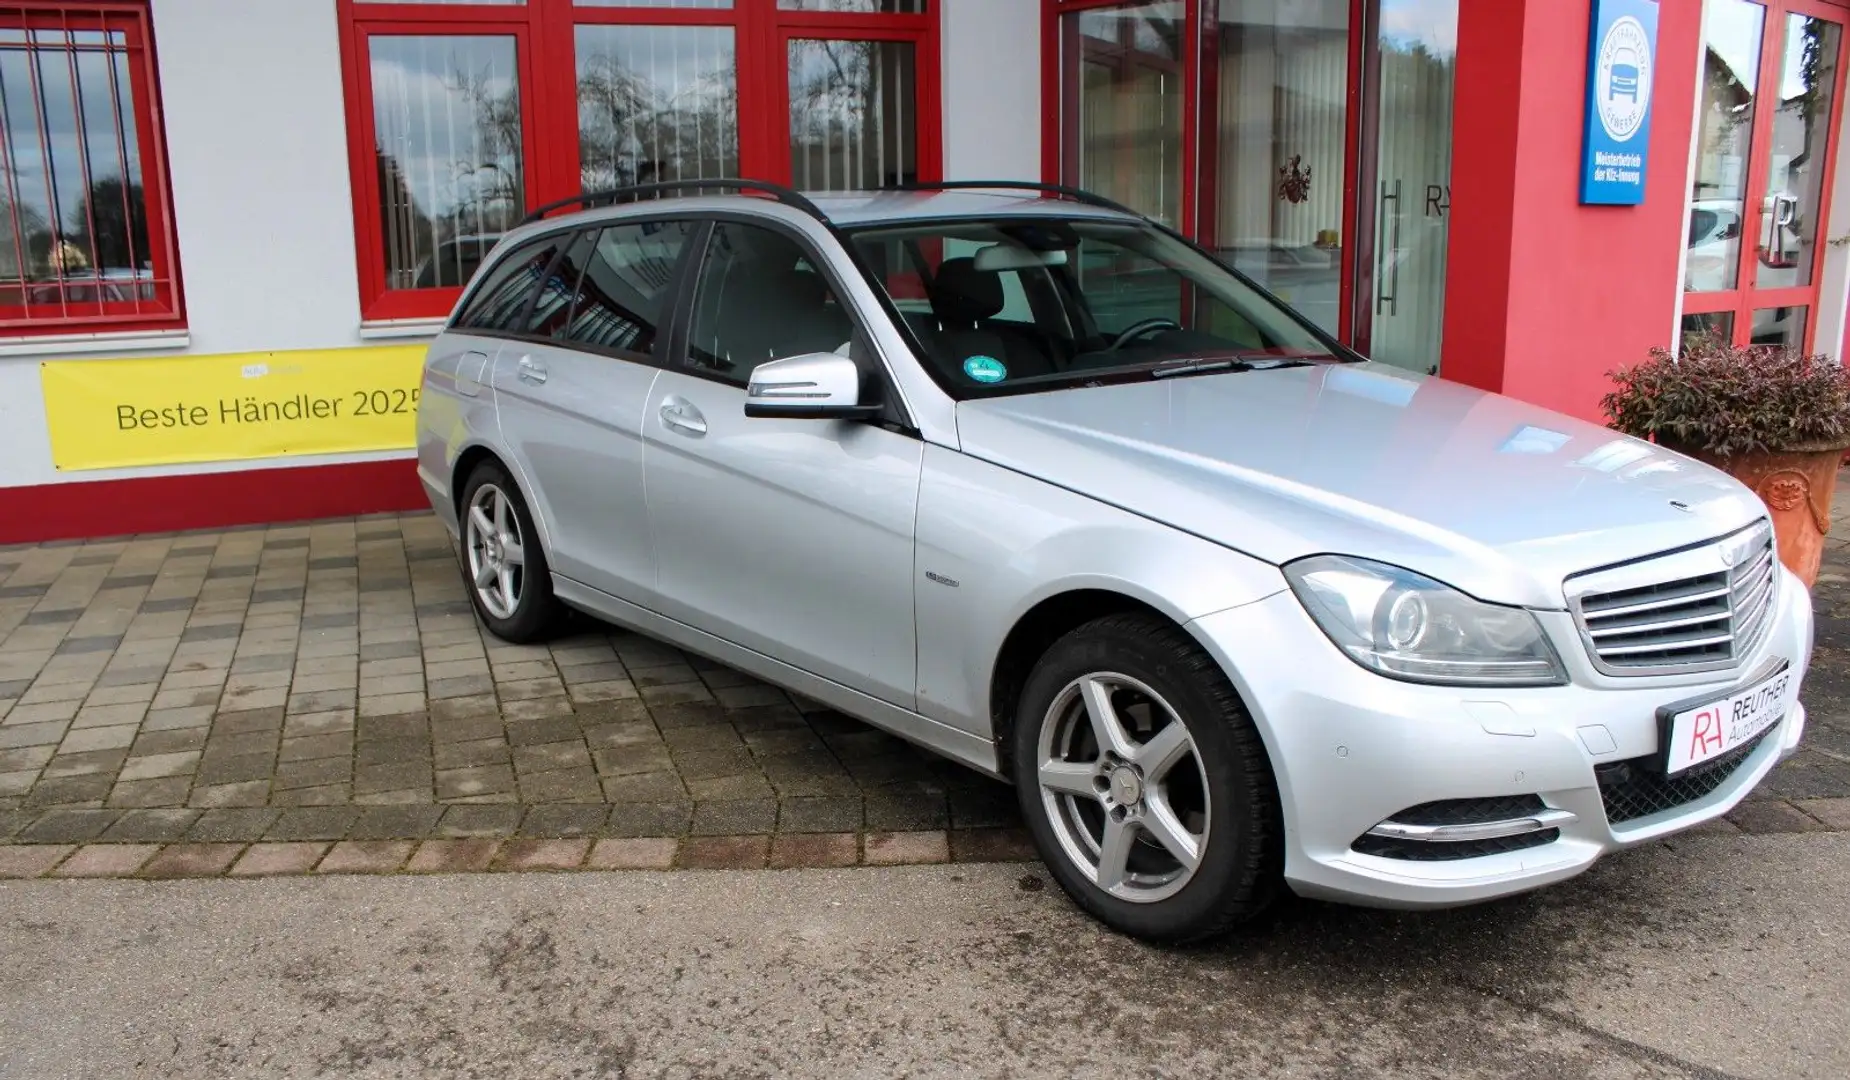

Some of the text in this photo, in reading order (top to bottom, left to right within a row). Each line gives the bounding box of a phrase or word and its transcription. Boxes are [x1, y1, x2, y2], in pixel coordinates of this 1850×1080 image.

[1595, 151, 1641, 167] Meisterbetrieb
[1594, 167, 1606, 181] der
[116, 402, 208, 430] Beste
[219, 394, 343, 424] Händler
[1731, 674, 1789, 723] REUTHER
